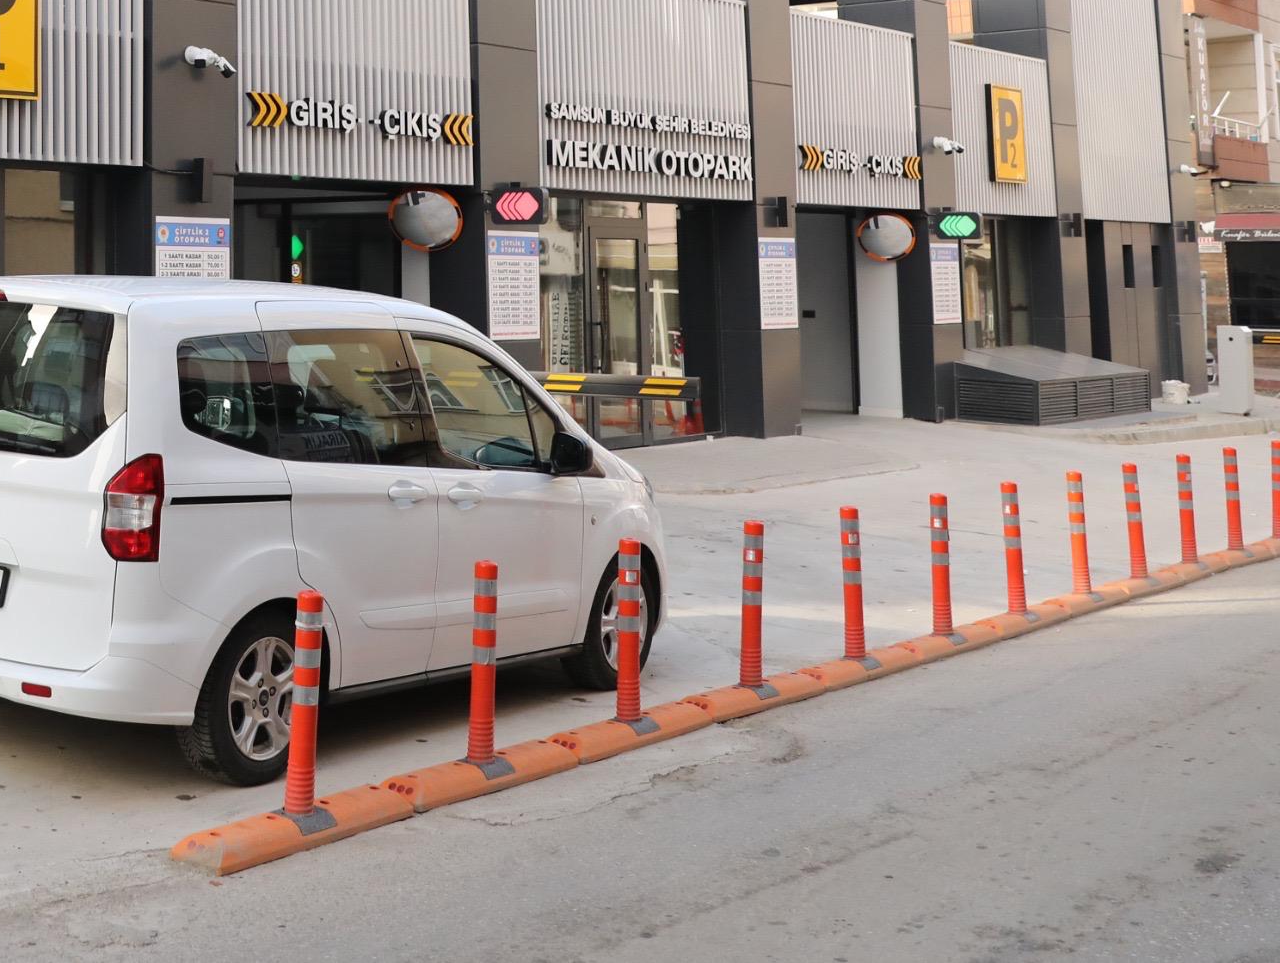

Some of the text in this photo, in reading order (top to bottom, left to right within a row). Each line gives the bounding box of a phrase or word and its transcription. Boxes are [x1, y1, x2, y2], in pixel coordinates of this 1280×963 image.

[290, 97, 357, 133] GİRİŞ
[384, 108, 442, 141] ÇIKIŞ
[550, 102, 606, 124] SAMSUN
[655, 114, 691, 133] ŞEHİR
[691, 119, 751, 140] BELEDİYESİ
[552, 139, 753, 181] MEKANİK OTOPARK
[823, 149, 859, 174] GİRİŞ
[872, 155, 904, 177] ÇIKIŞ
[175, 227, 204, 236] ÇİFTLİK
